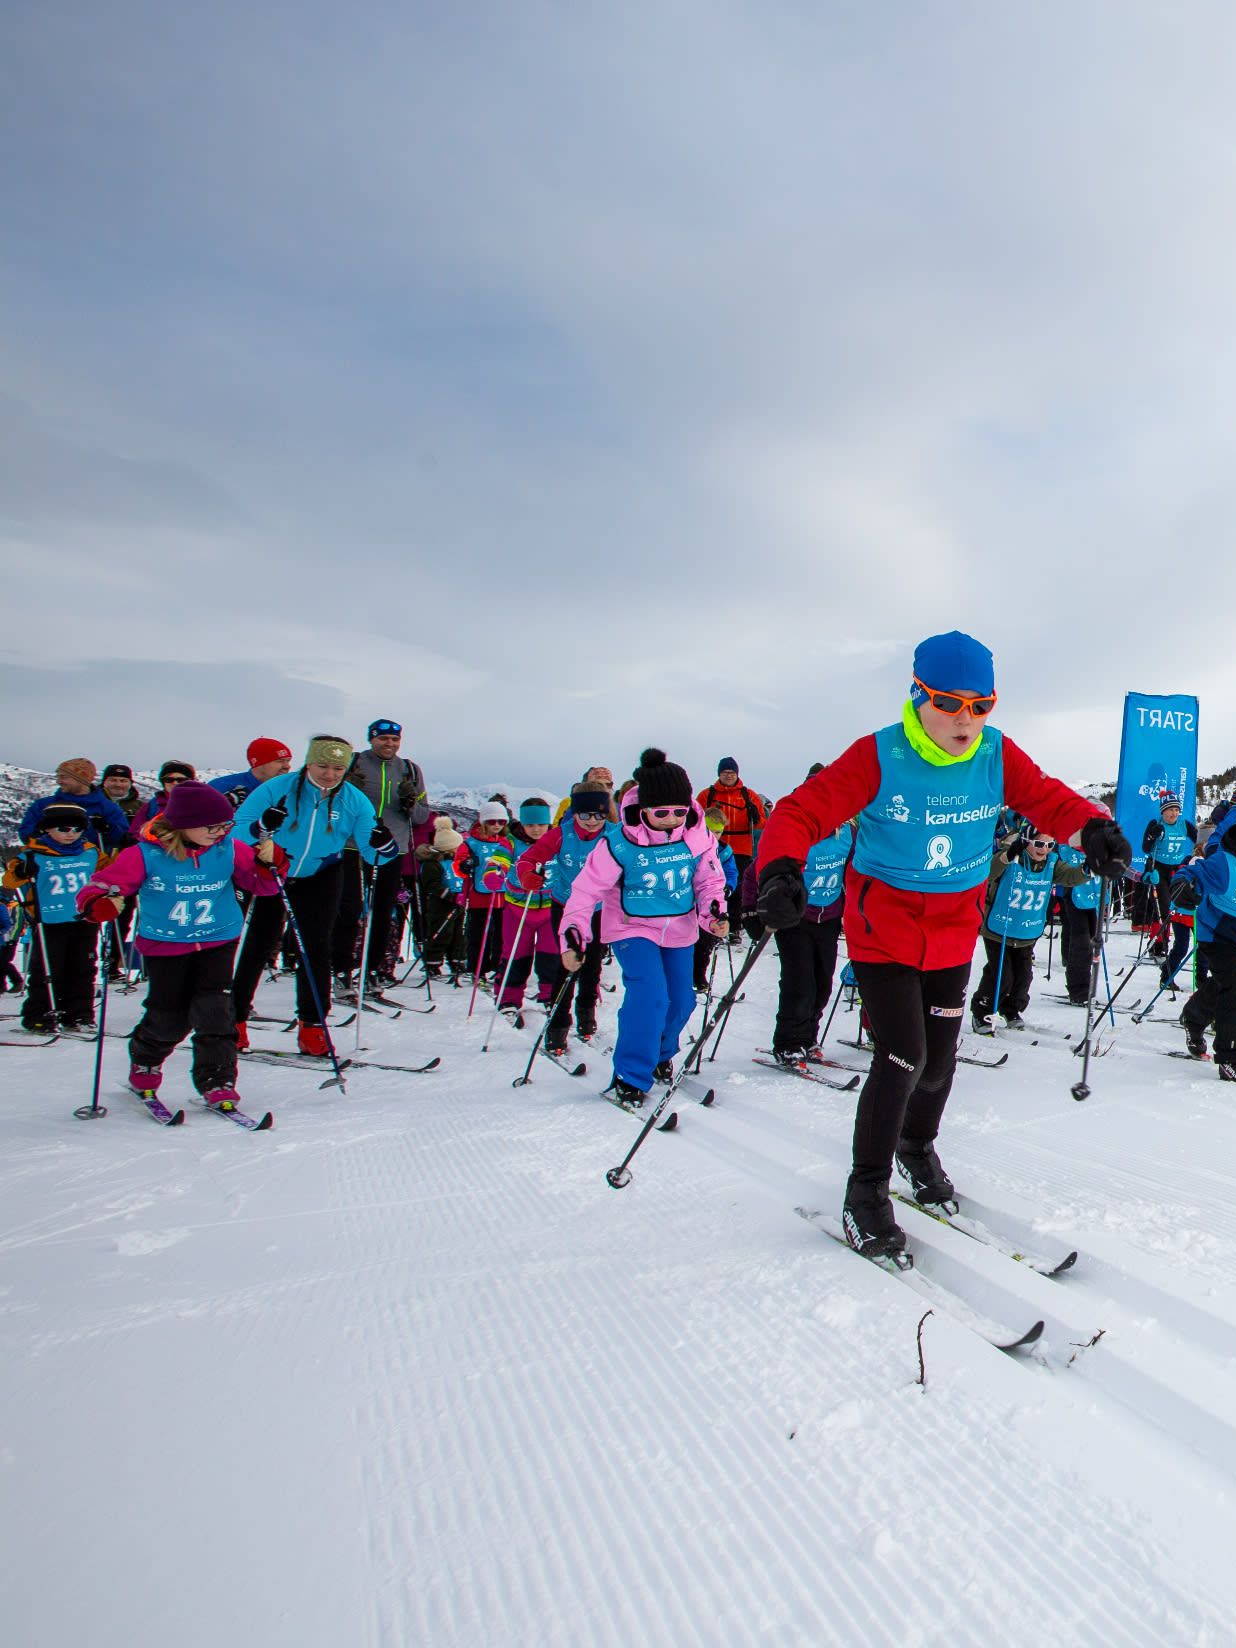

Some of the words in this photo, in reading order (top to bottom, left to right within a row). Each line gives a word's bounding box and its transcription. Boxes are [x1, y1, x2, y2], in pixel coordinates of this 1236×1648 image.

[926, 794, 969, 806] telenor
[925, 803, 1001, 826] karusellen
[923, 834, 953, 871] 8
[815, 857, 847, 871] karusell
[175, 873, 208, 883] telenor
[1008, 888, 1047, 911] 225
[168, 899, 215, 927] 42
[888, 1053, 915, 1072] umbro
